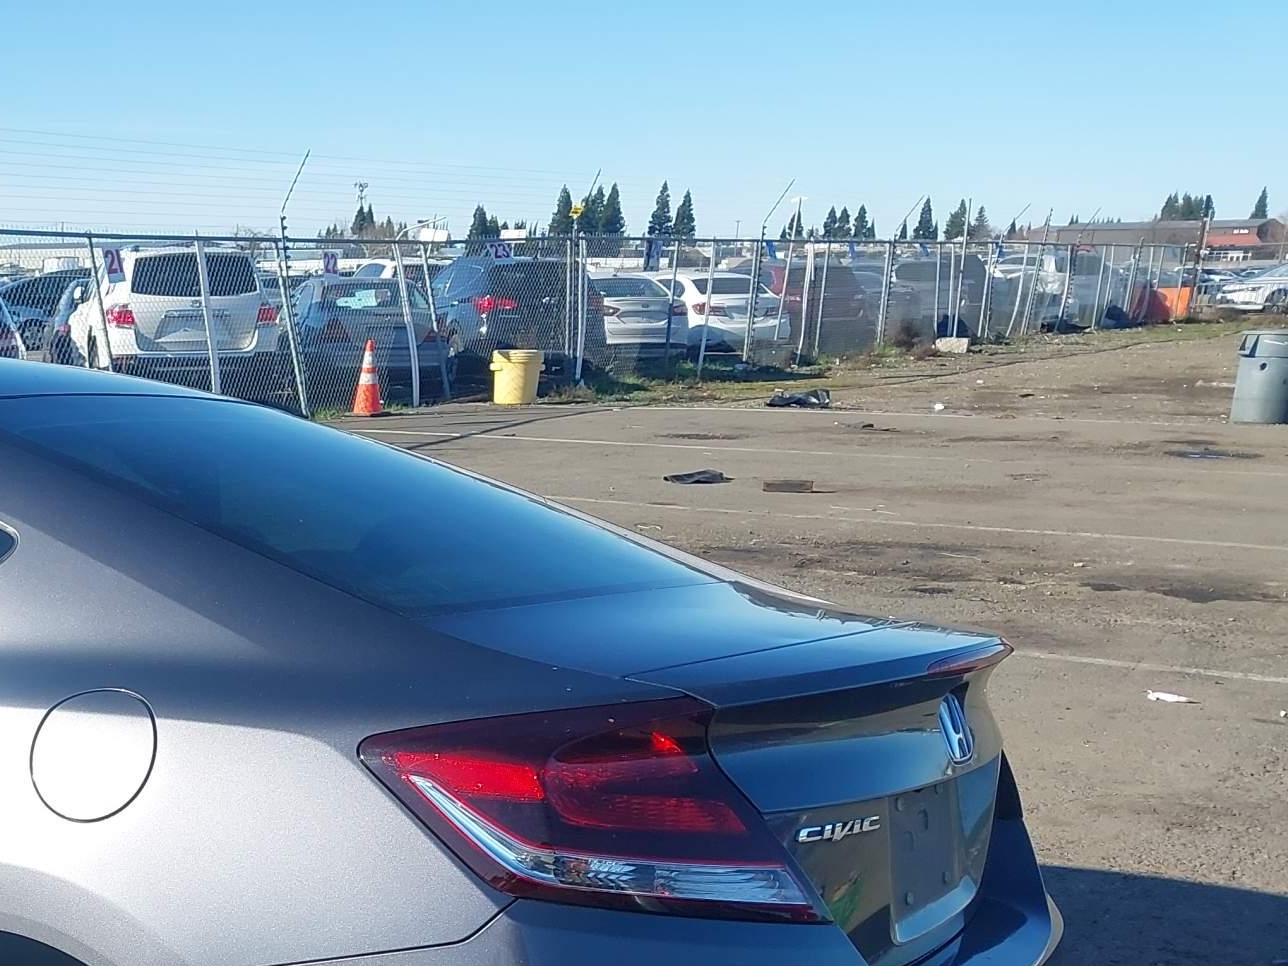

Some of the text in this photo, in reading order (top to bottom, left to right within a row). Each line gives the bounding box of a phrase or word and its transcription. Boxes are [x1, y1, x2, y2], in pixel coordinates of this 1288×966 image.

[104, 249, 124, 274] 21
[323, 252, 338, 274] 22
[489, 244, 510, 259] 23
[797, 815, 881, 843] CIVIC
